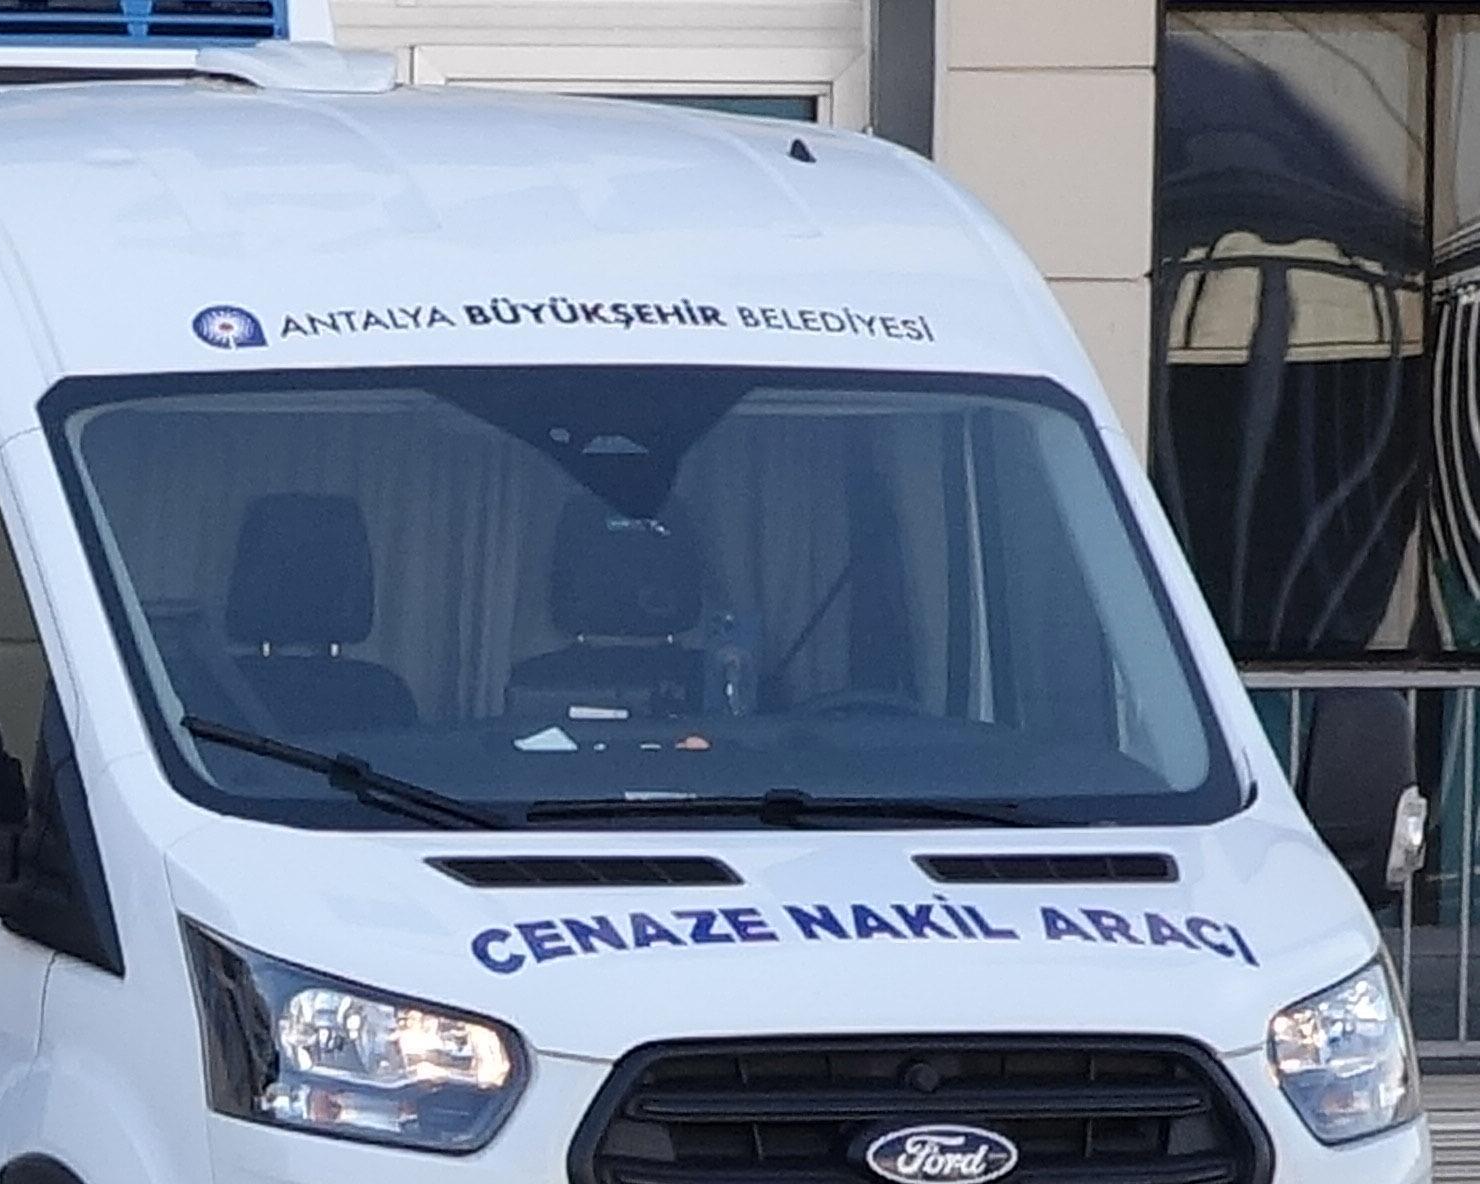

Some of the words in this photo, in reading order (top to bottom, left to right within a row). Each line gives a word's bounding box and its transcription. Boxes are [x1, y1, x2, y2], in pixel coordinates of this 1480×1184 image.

[281, 304, 456, 339] ANTALYA
[463, 296, 728, 330] BÜYÜKŞEHİR
[736, 305, 935, 343] BELEDİYESİ
[471, 906, 780, 974] CENAZE
[783, 893, 1020, 941] NAKİL
[1040, 905, 1260, 968] ARACI
[897, 1135, 990, 1175] Ford
